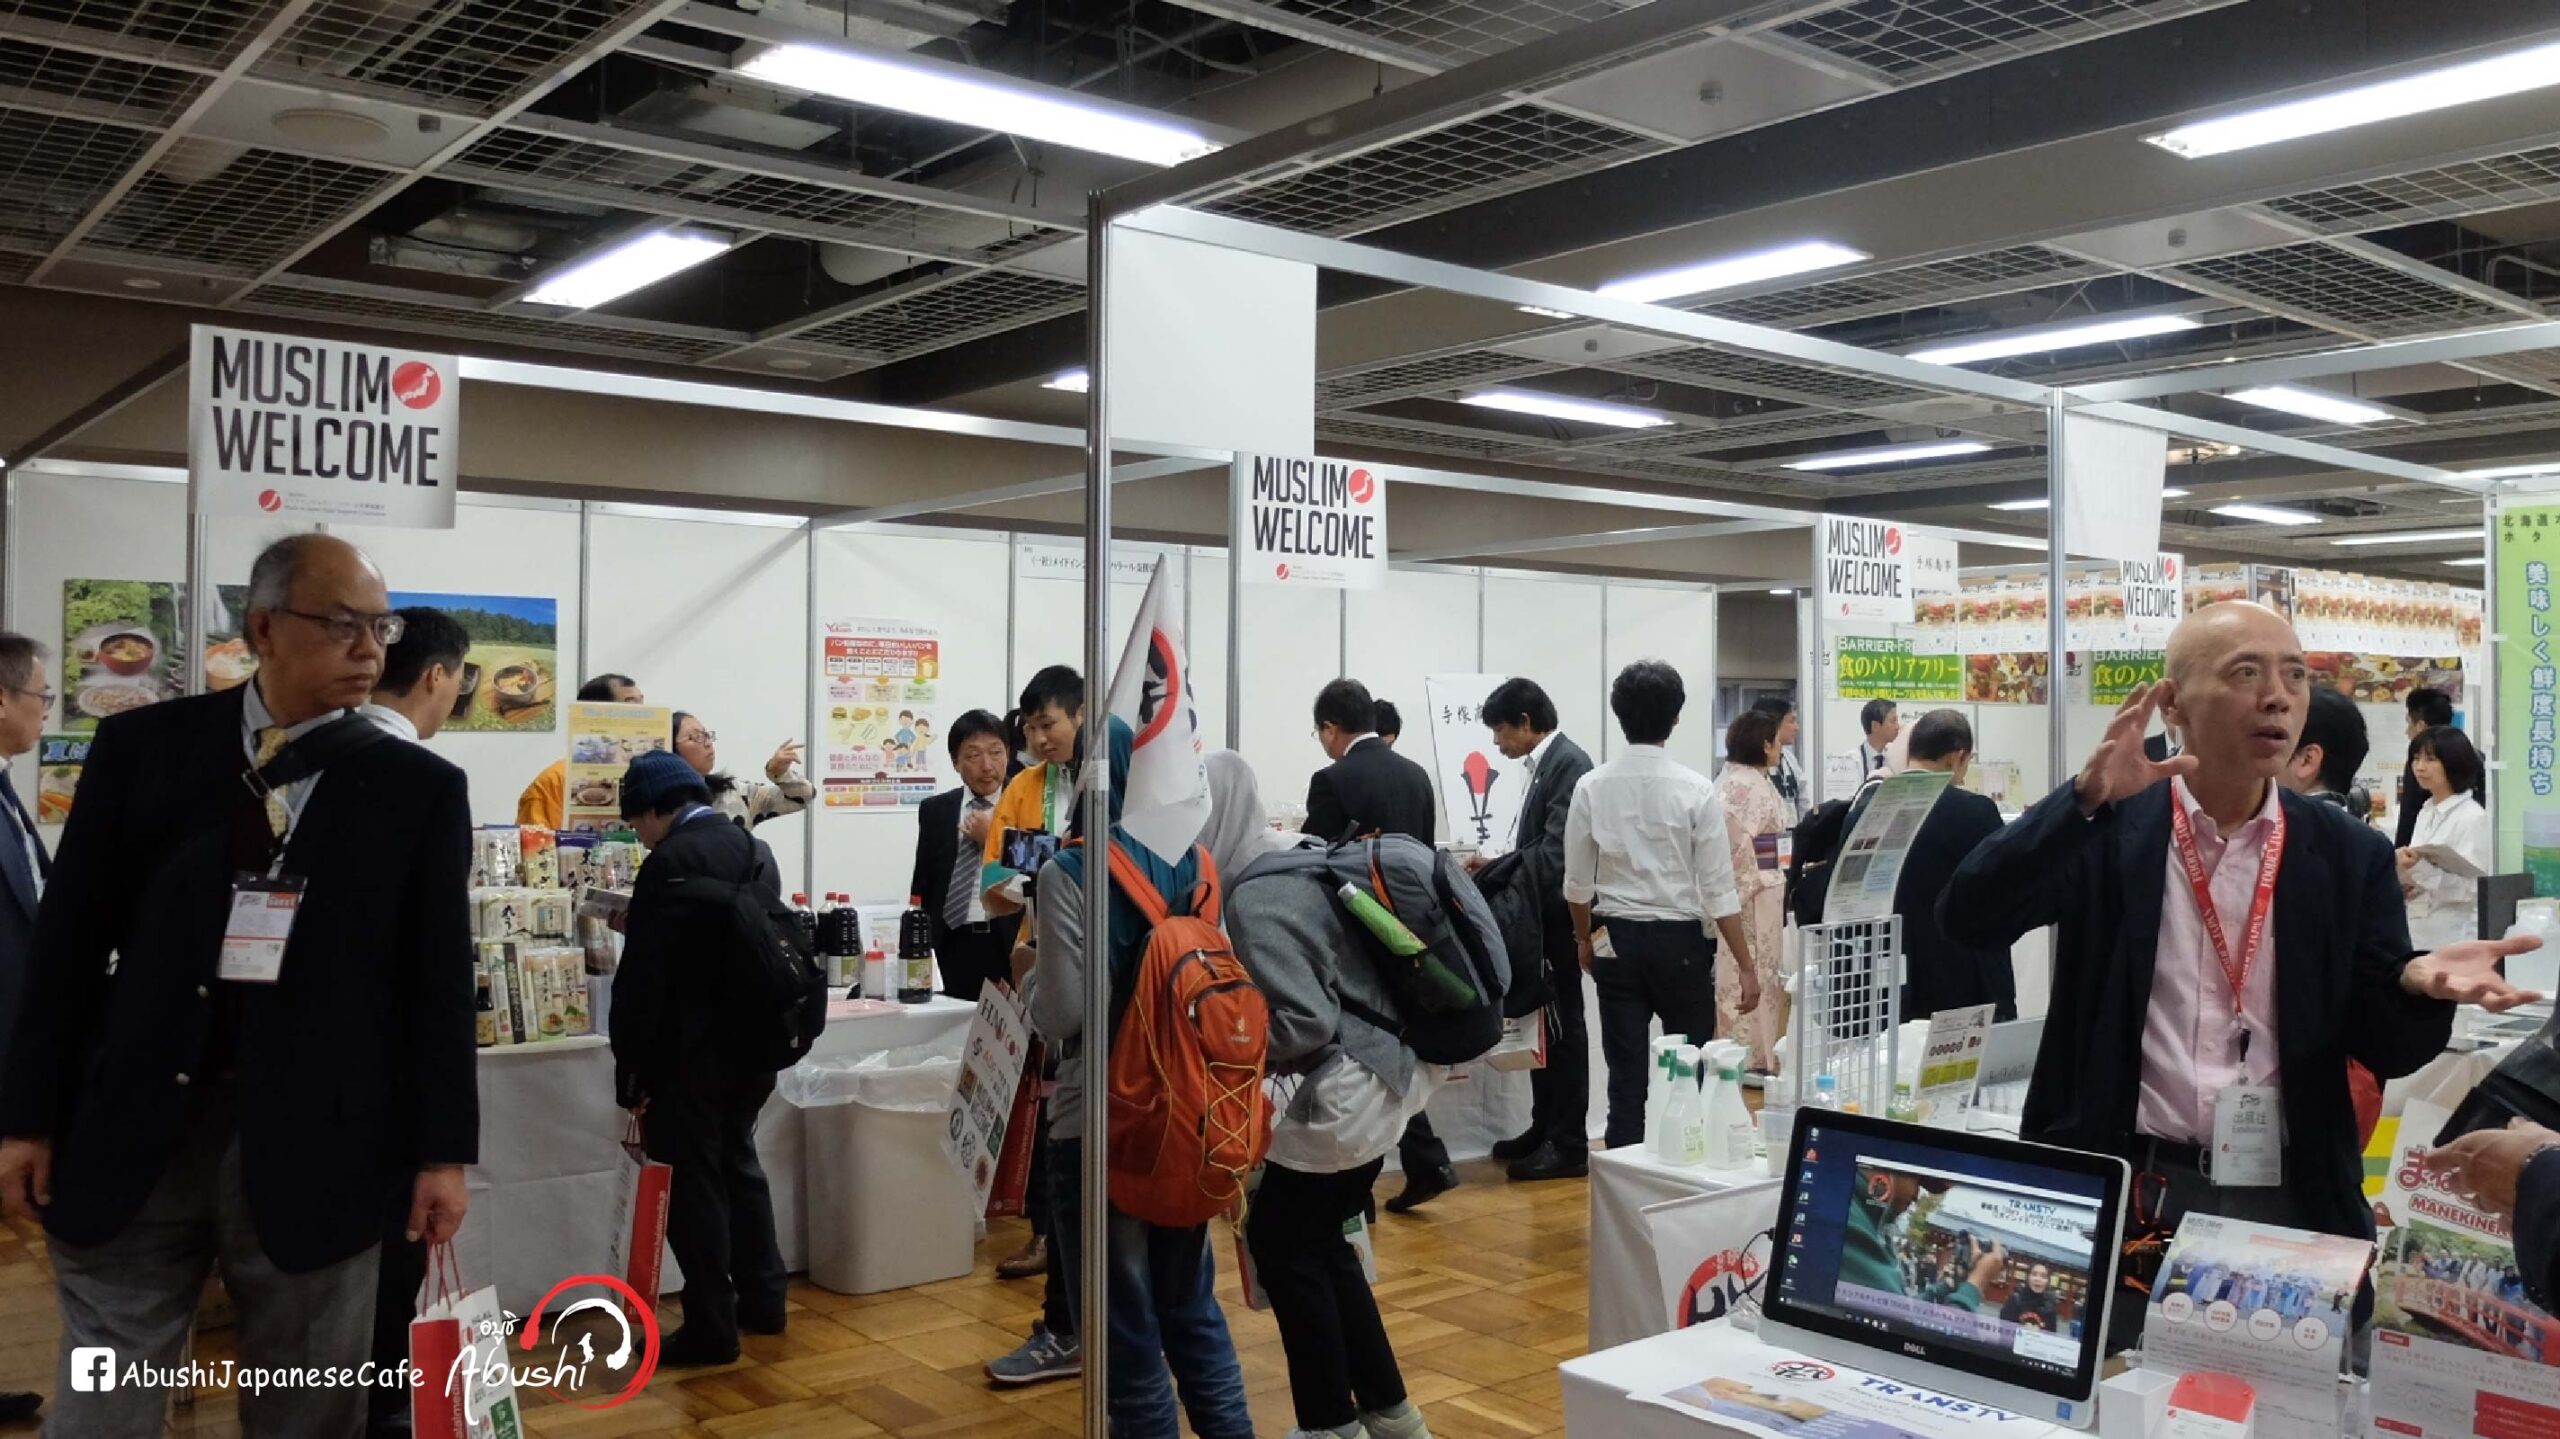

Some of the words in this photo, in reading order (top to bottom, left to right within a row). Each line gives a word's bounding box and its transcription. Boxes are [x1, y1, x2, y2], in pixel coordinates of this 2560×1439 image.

[211, 336, 390, 415] MUSLIM
[212, 405, 439, 487] WELCOME
[1253, 455, 1348, 508] MUSLIM
[1253, 505, 1375, 559] WELCOME
[1828, 519, 1886, 558] MUSLIM
[1828, 558, 1902, 598] WELCOME
[2122, 555, 2166, 585] MUSLIM
[2124, 586, 2177, 618] WELCOME
[1839, 653, 1960, 680] 食のバリアフリー
[2526, 561, 2557, 795] 美味しく鮮度長持ち
[2260, 848, 2279, 889] FOODEX
[1904, 1342, 1926, 1355] DELL
